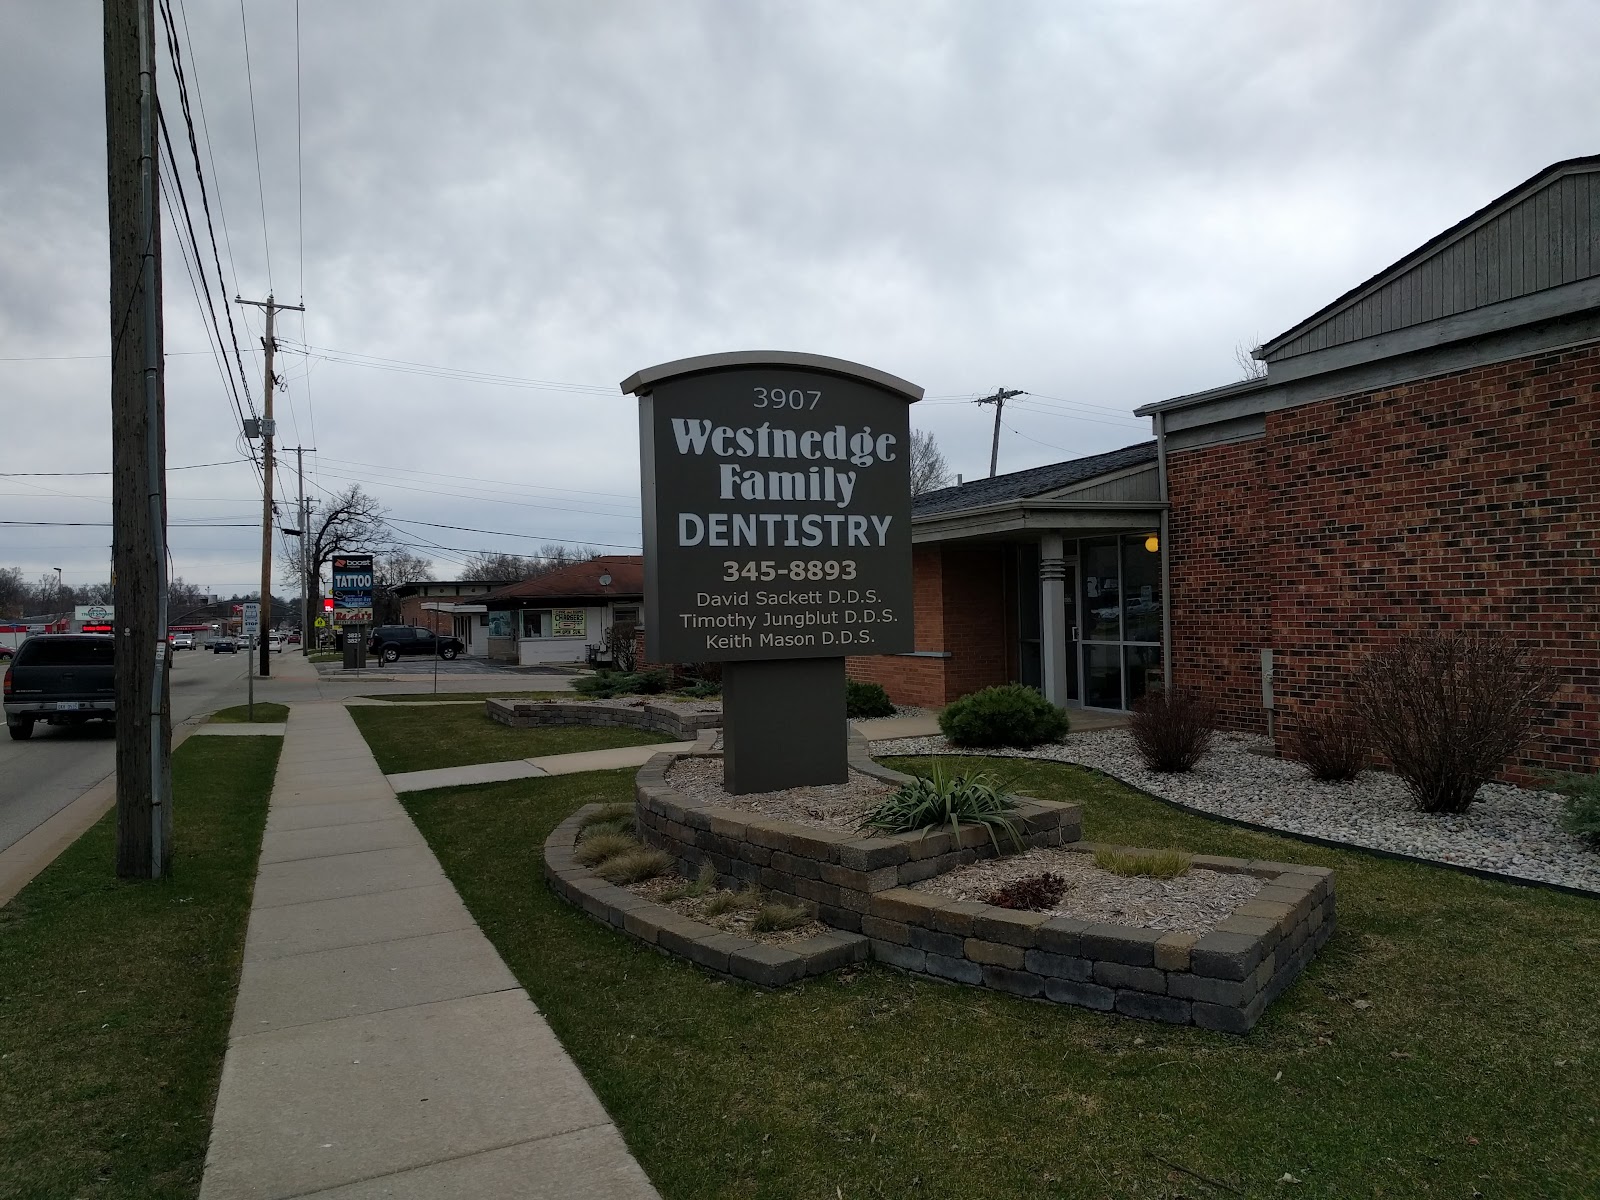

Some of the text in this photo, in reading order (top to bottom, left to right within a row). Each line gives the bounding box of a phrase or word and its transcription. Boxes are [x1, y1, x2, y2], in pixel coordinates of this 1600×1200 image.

[753, 387, 822, 410] 3907
[671, 418, 897, 468] Westnedge
[719, 463, 857, 508] Family
[678, 512, 893, 547] DENTISTRY
[335, 575, 371, 587] TATTOO
[723, 560, 857, 582] 345-8893
[697, 589, 882, 607] David Sackett D.D.S.
[679, 609, 898, 629] Timothy Jungblut D.D.S.
[705, 630, 876, 649] Keith Mason D.D.S.
